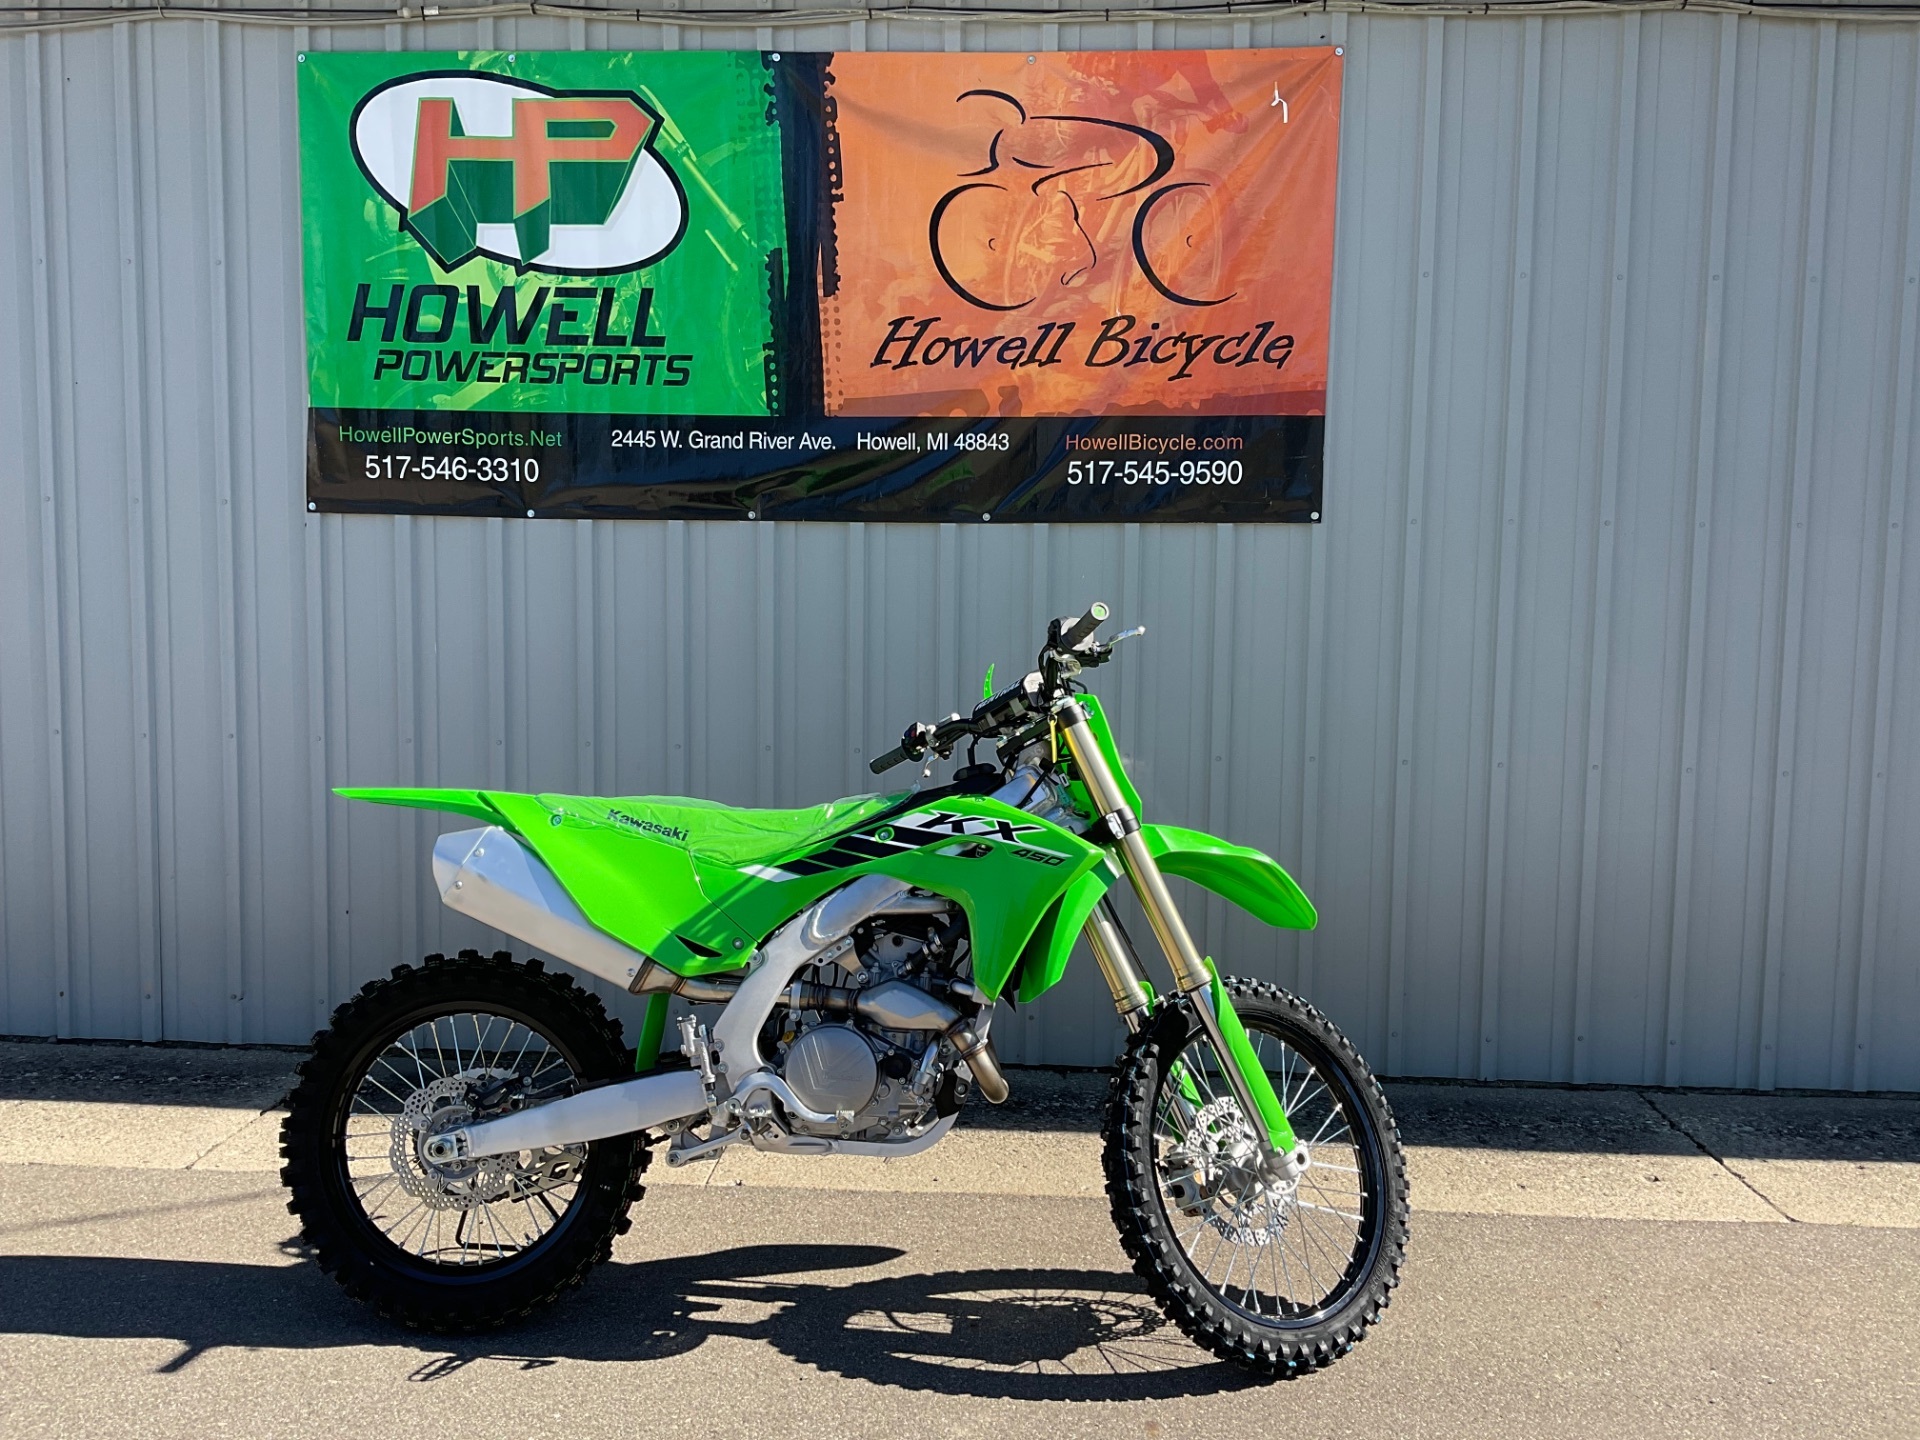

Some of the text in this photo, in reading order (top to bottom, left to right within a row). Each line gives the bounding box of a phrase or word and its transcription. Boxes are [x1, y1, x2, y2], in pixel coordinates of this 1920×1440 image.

[347, 283, 667, 347] HOWELL
[870, 315, 1295, 381] Howell Bicycle
[373, 349, 693, 387] POWERSPORTS
[339, 426, 563, 449] HowellPowerSports.Net
[611, 429, 1010, 453] 2445 W. Grand River Ave. Howell, MI 48843
[1065, 434, 1243, 454] HowellBicycle.com
[365, 455, 539, 483] 517-546-3310
[1067, 460, 1243, 486] 517-545-9590
[606, 808, 690, 842] Kawasaki
[916, 811, 1046, 844] KX
[1012, 848, 1066, 867] 450
